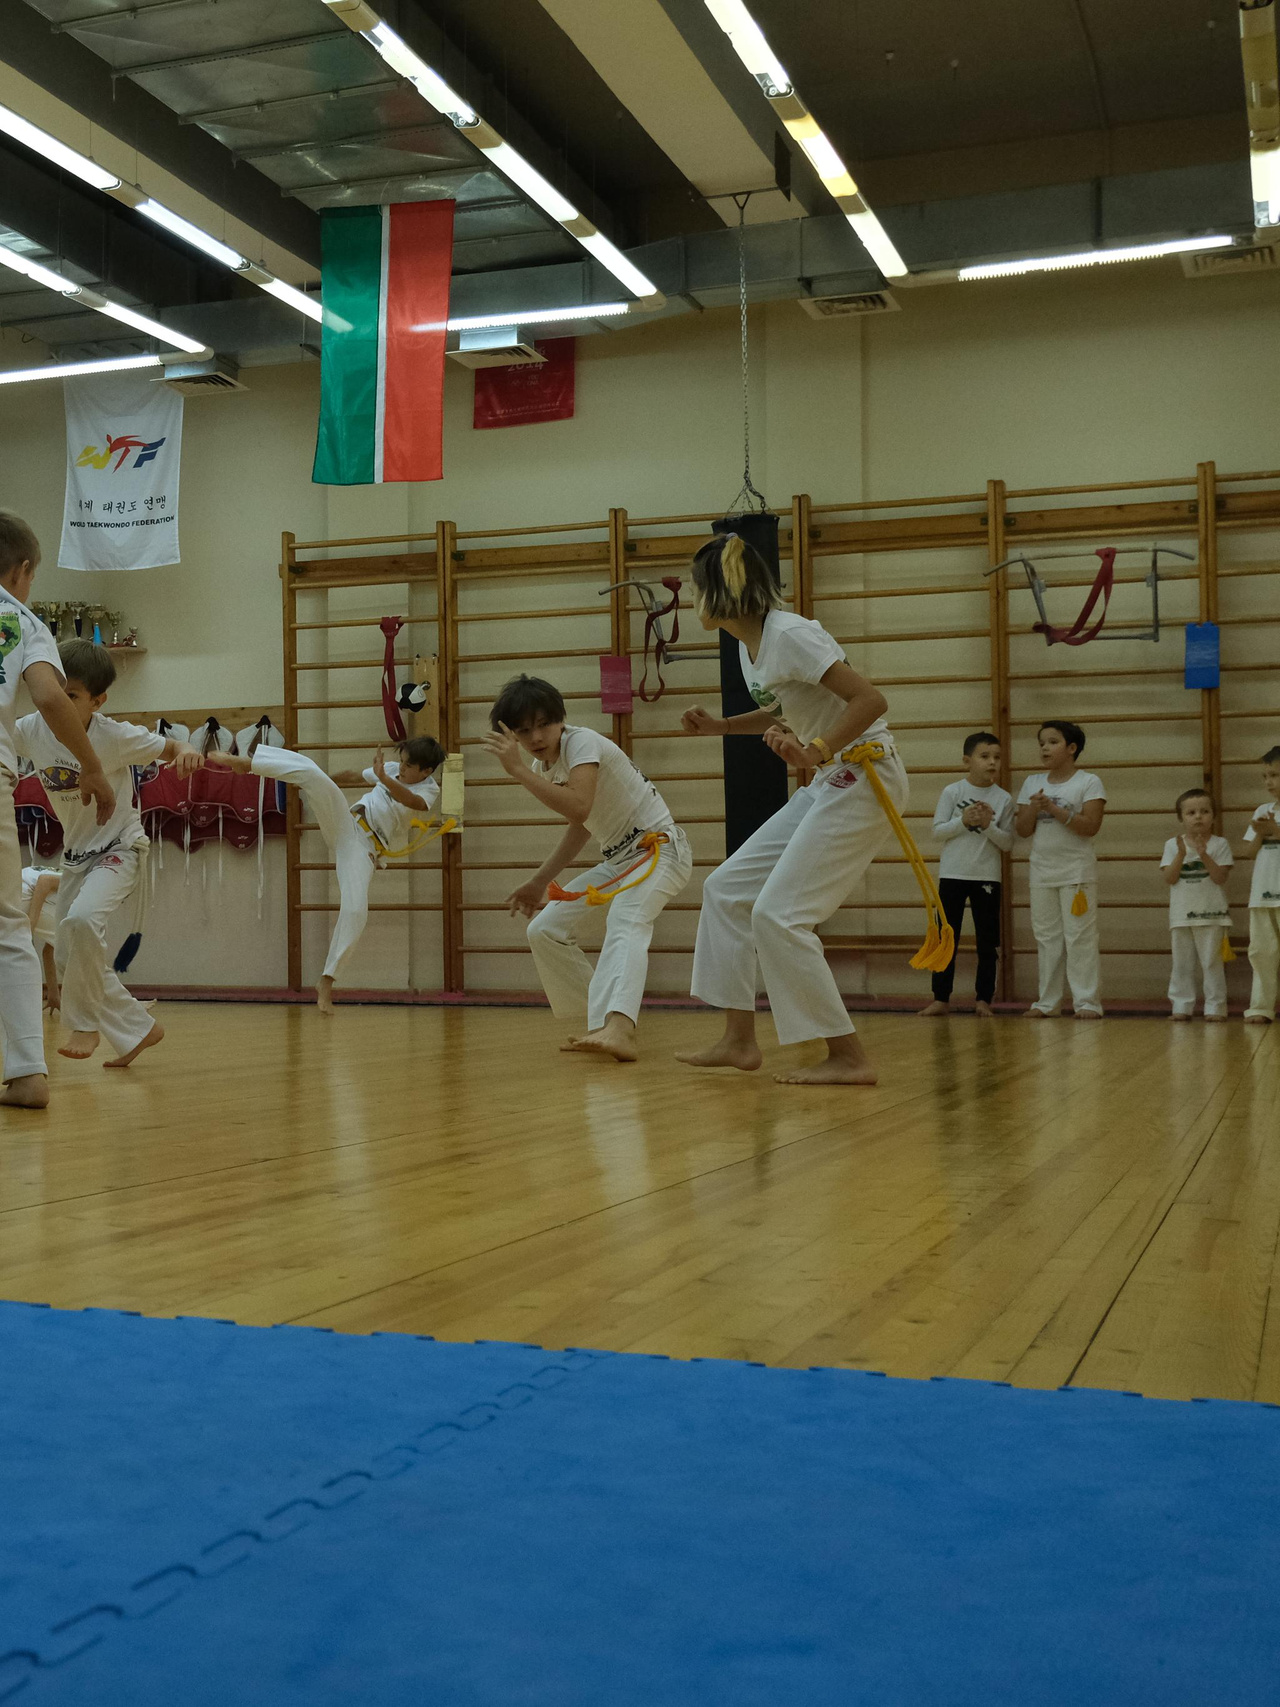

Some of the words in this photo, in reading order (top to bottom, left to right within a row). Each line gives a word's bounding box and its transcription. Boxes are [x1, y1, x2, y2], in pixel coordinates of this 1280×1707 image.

[75, 434, 167, 475] WTF
[103, 500, 138, 515] 태권도
[144, 495, 167, 511] 연맹
[87, 520, 131, 529] TAEKWONDO
[131, 515, 175, 528] FEDERATION
